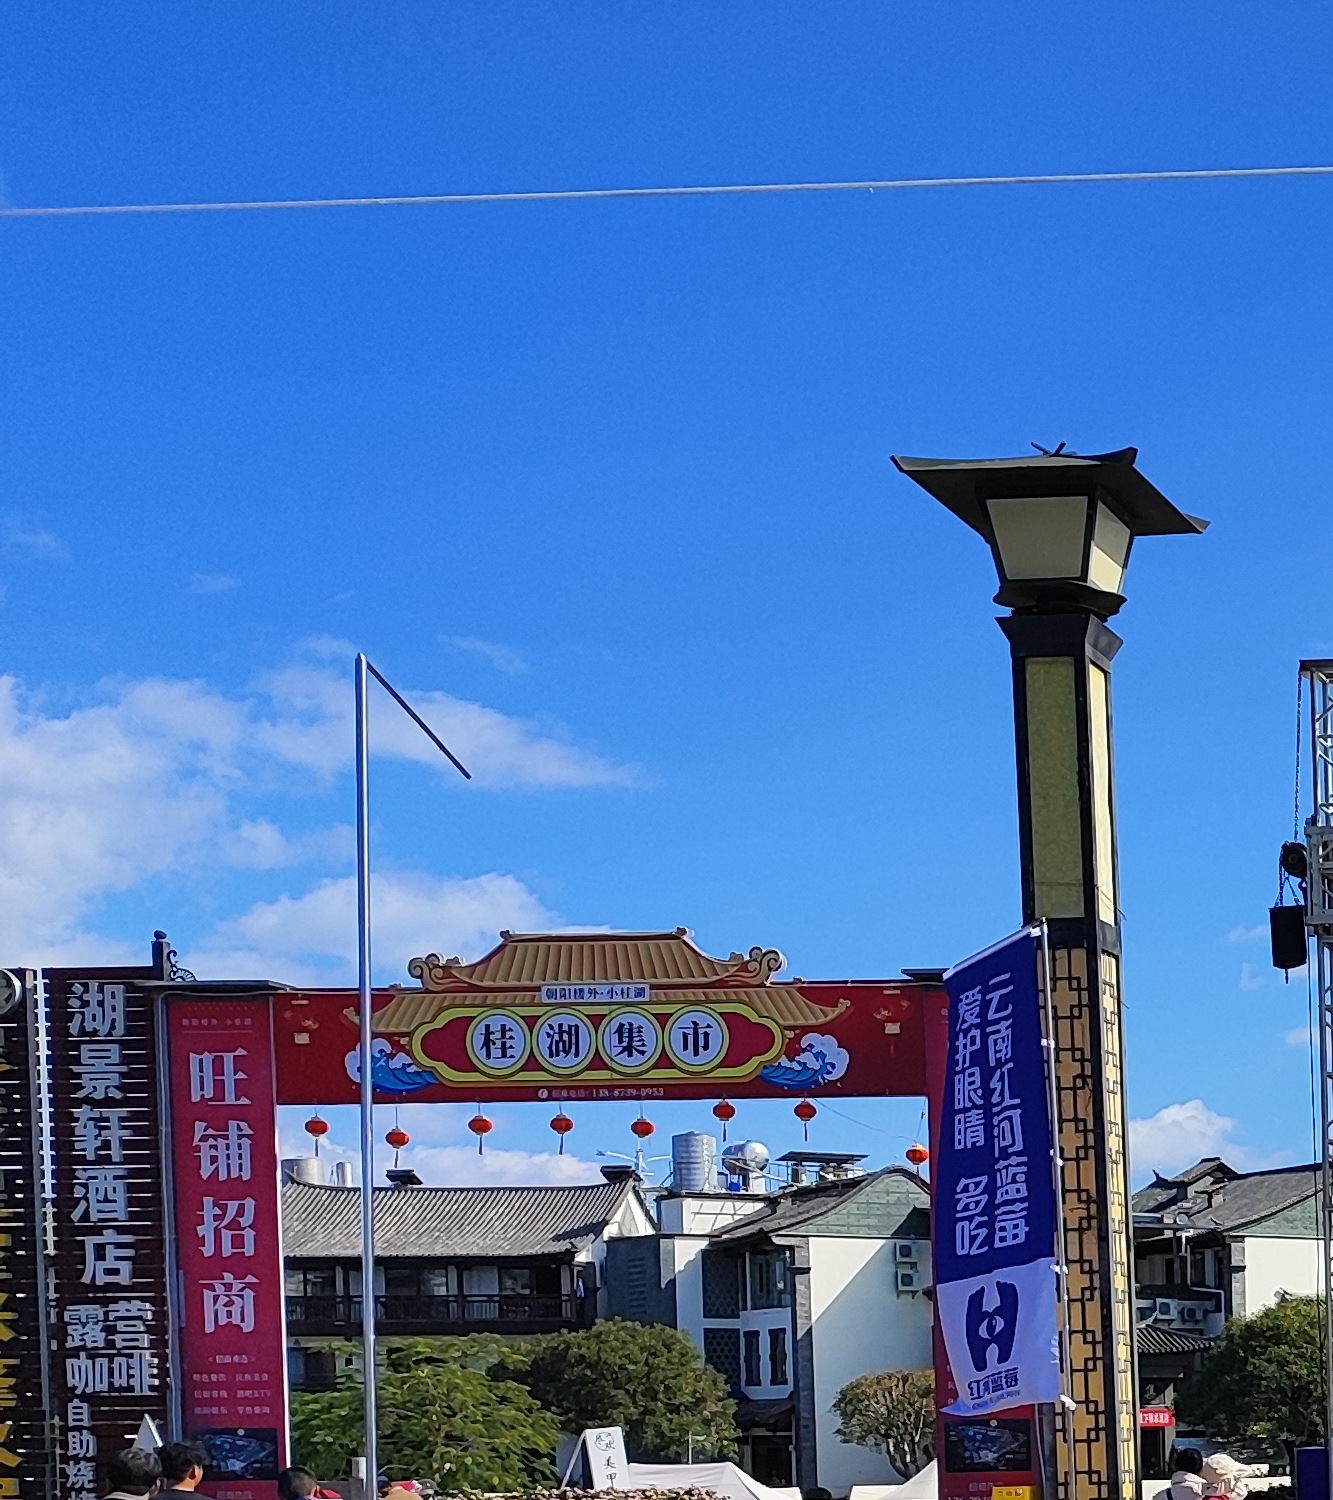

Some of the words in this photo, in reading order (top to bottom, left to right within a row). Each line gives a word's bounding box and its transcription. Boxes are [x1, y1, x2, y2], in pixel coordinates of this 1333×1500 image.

[479, 1020, 714, 1060] 桂湖集市
[954, 985, 985, 1150] 爱护眼睛
[67, 981, 136, 1286] 湖景轩酒店
[985, 972, 1030, 1249] 云南红河蓝莓
[189, 1046, 260, 1334] 旺铺招商
[955, 1174, 989, 1256] 多吃
[64, 1300, 153, 1348] 露营
[66, 1352, 158, 1394] 咖啡
